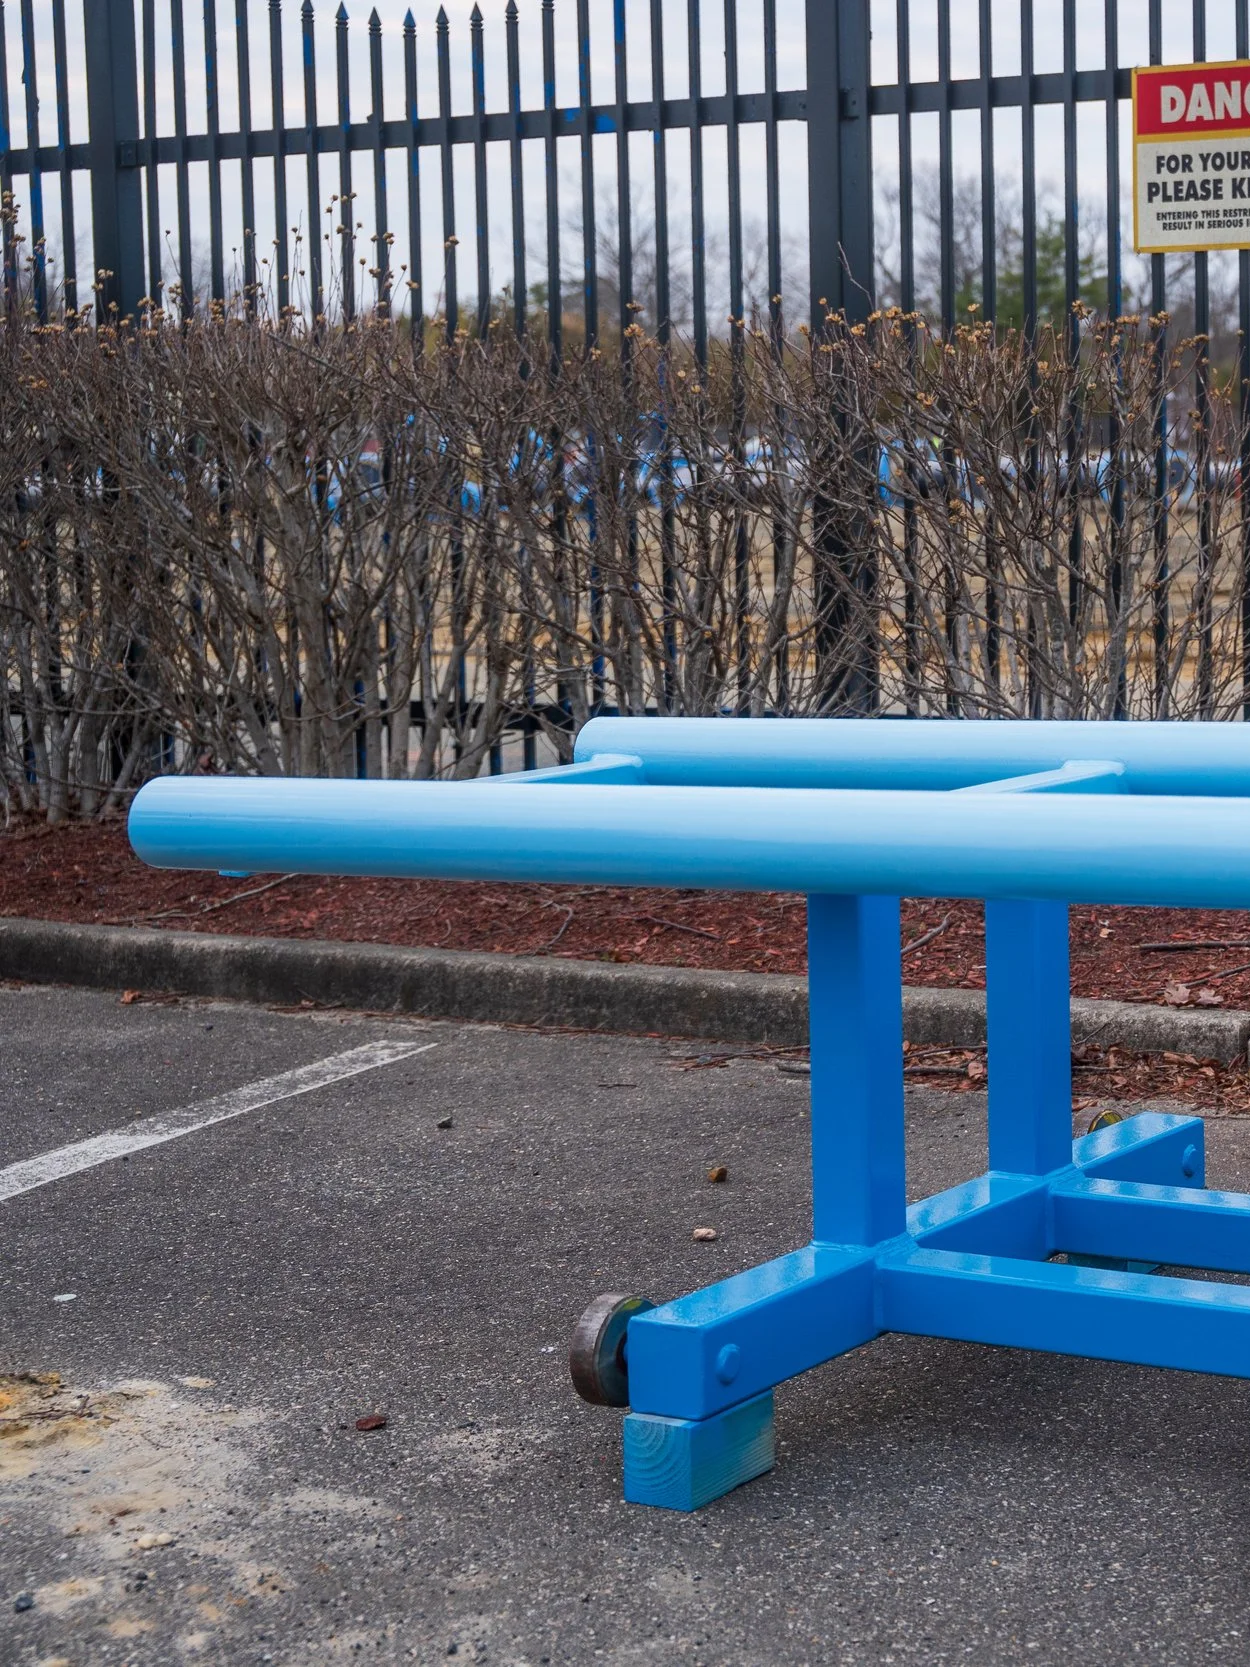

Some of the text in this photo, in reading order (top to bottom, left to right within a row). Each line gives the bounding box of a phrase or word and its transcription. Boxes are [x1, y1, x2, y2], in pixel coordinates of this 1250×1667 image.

[1156, 154, 1193, 174] FOR
[1147, 179, 1223, 203] PLEASE
[1156, 211, 1198, 221] ENTERING
[1201, 210, 1220, 219] THIS
[1162, 221, 1192, 231] RESULT
[1195, 220, 1204, 229] IN
[1207, 218, 1243, 228] SERIOUS
